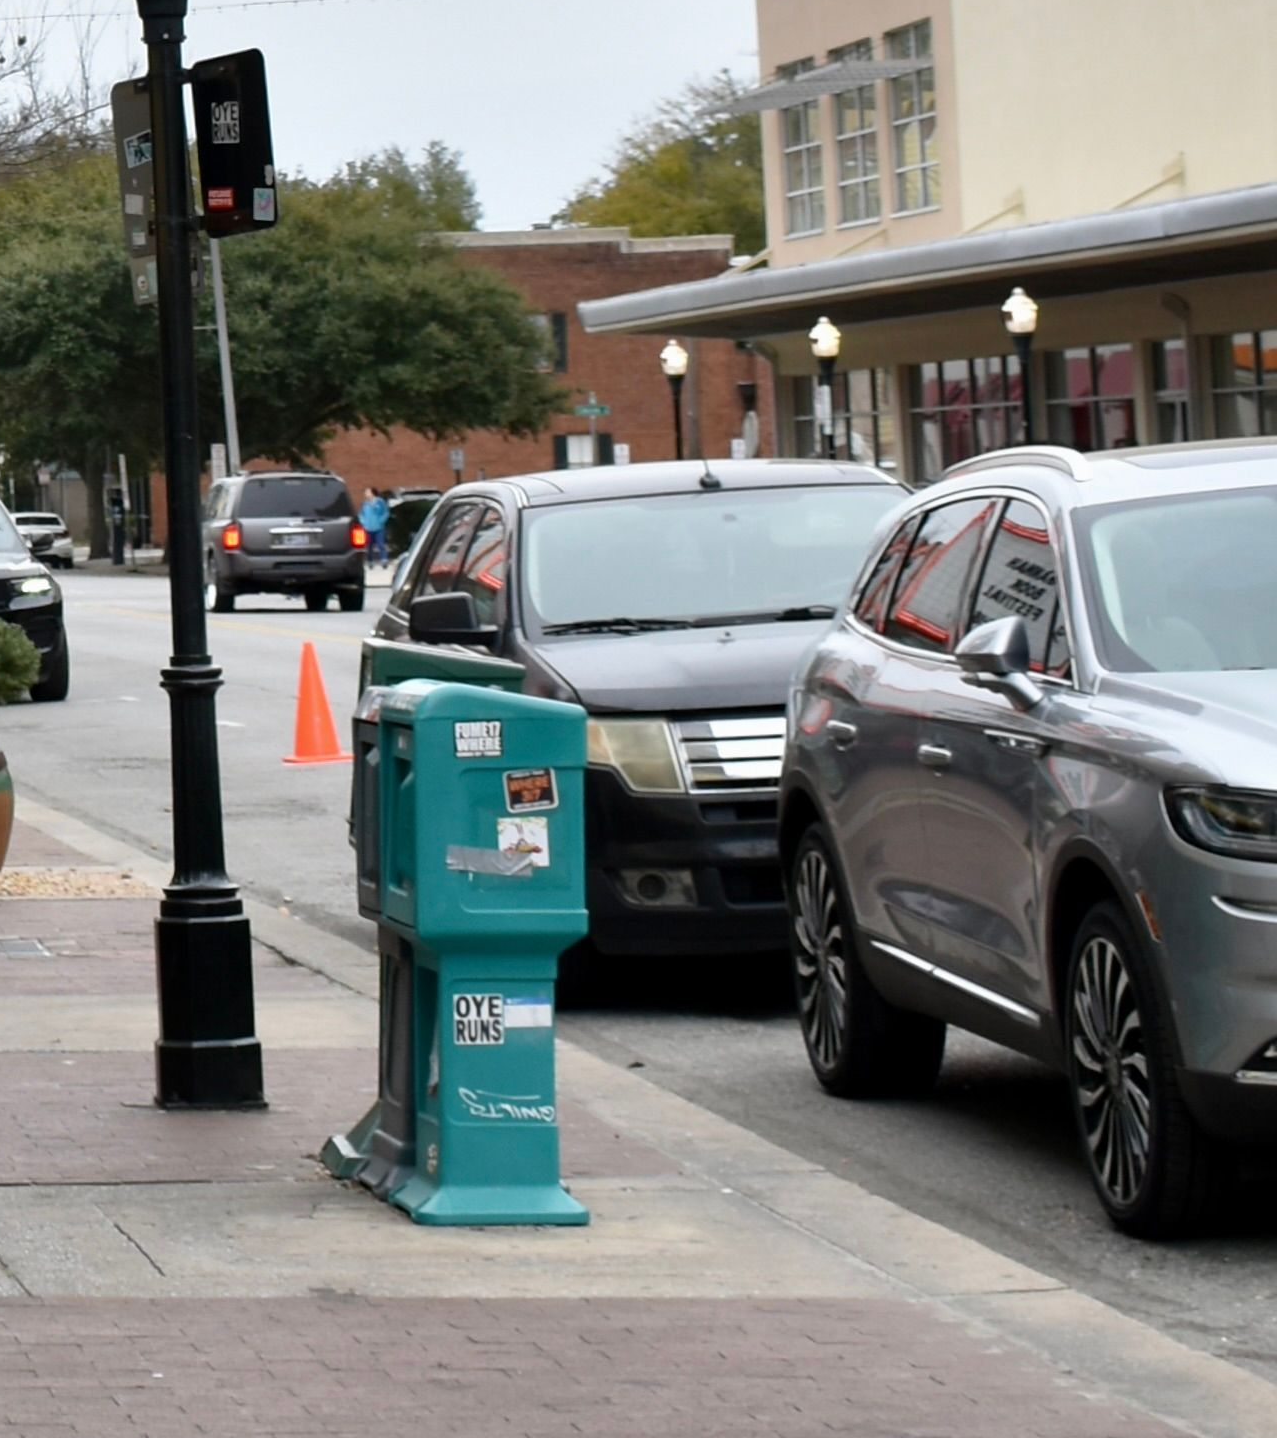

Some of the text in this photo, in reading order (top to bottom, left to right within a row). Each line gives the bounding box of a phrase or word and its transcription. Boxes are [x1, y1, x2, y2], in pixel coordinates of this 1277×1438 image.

[213, 102, 238, 122] OYE
[213, 123, 239, 142] RUNS
[455, 737, 502, 751] WHERE
[455, 995, 501, 1018] OYE
[456, 1019, 502, 1043] RUNS
